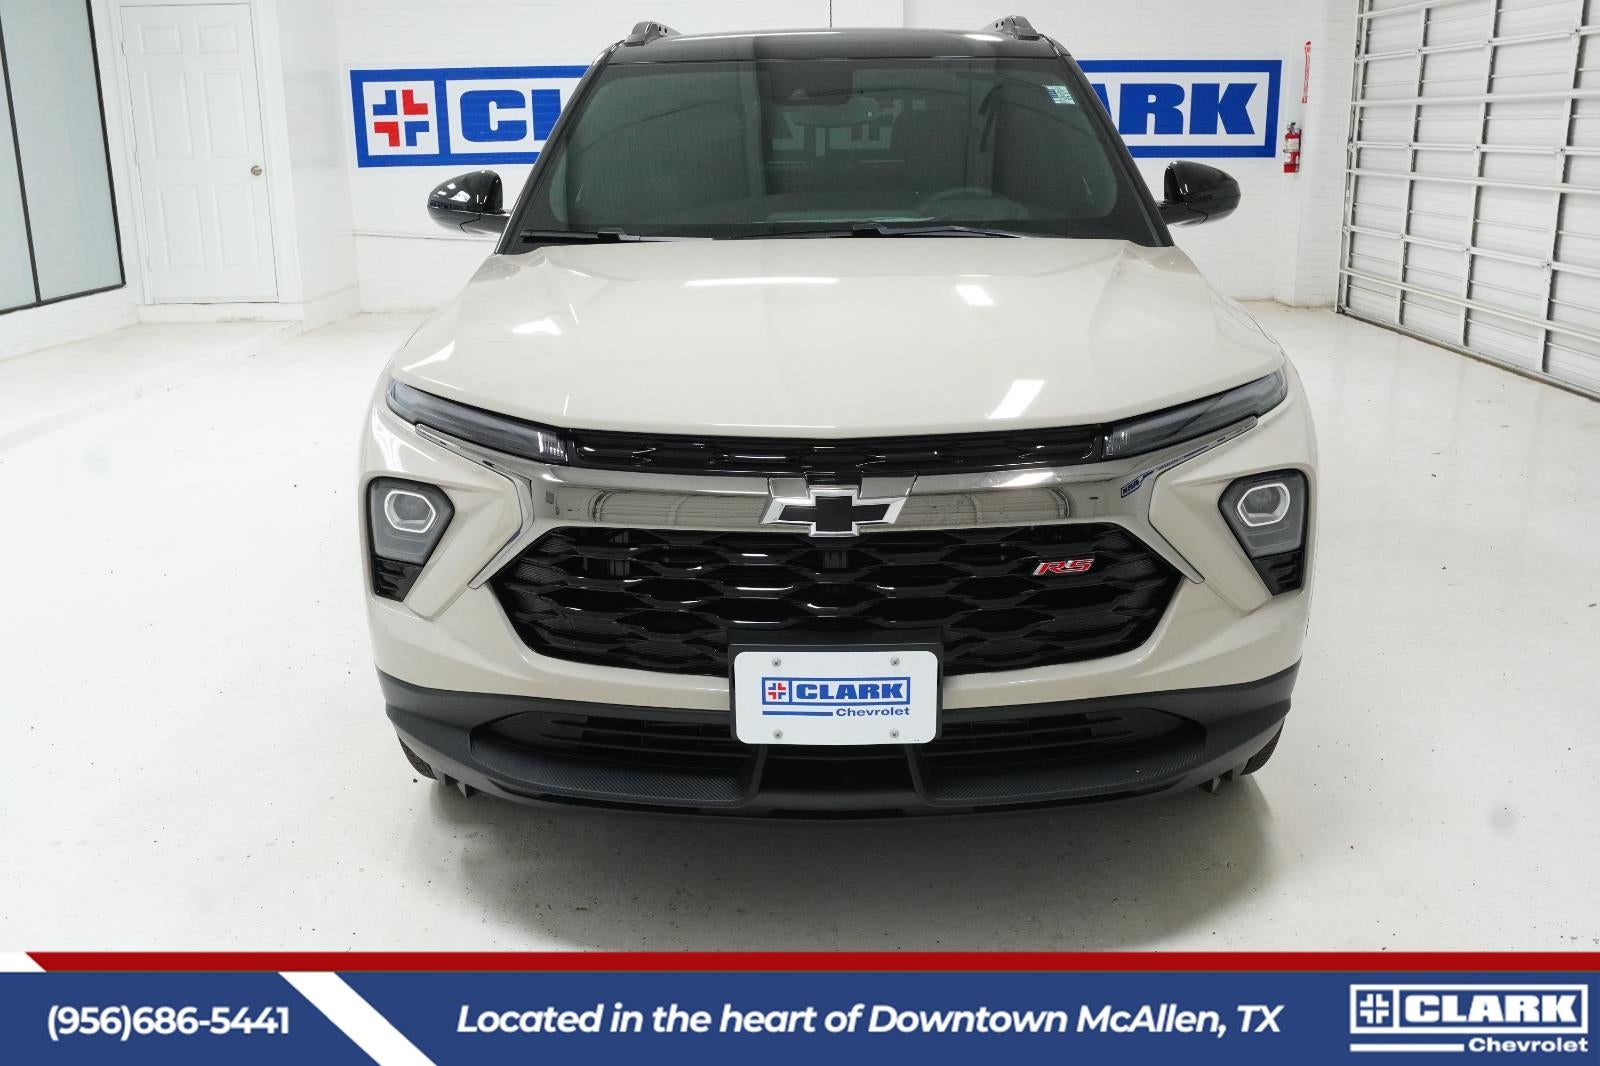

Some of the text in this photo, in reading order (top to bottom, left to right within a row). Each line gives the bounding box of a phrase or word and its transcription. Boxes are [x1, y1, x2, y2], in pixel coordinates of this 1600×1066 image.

[1032, 558, 1095, 576] RS
[796, 683, 904, 700] CLARK
[835, 706, 911, 717] Chevrolet
